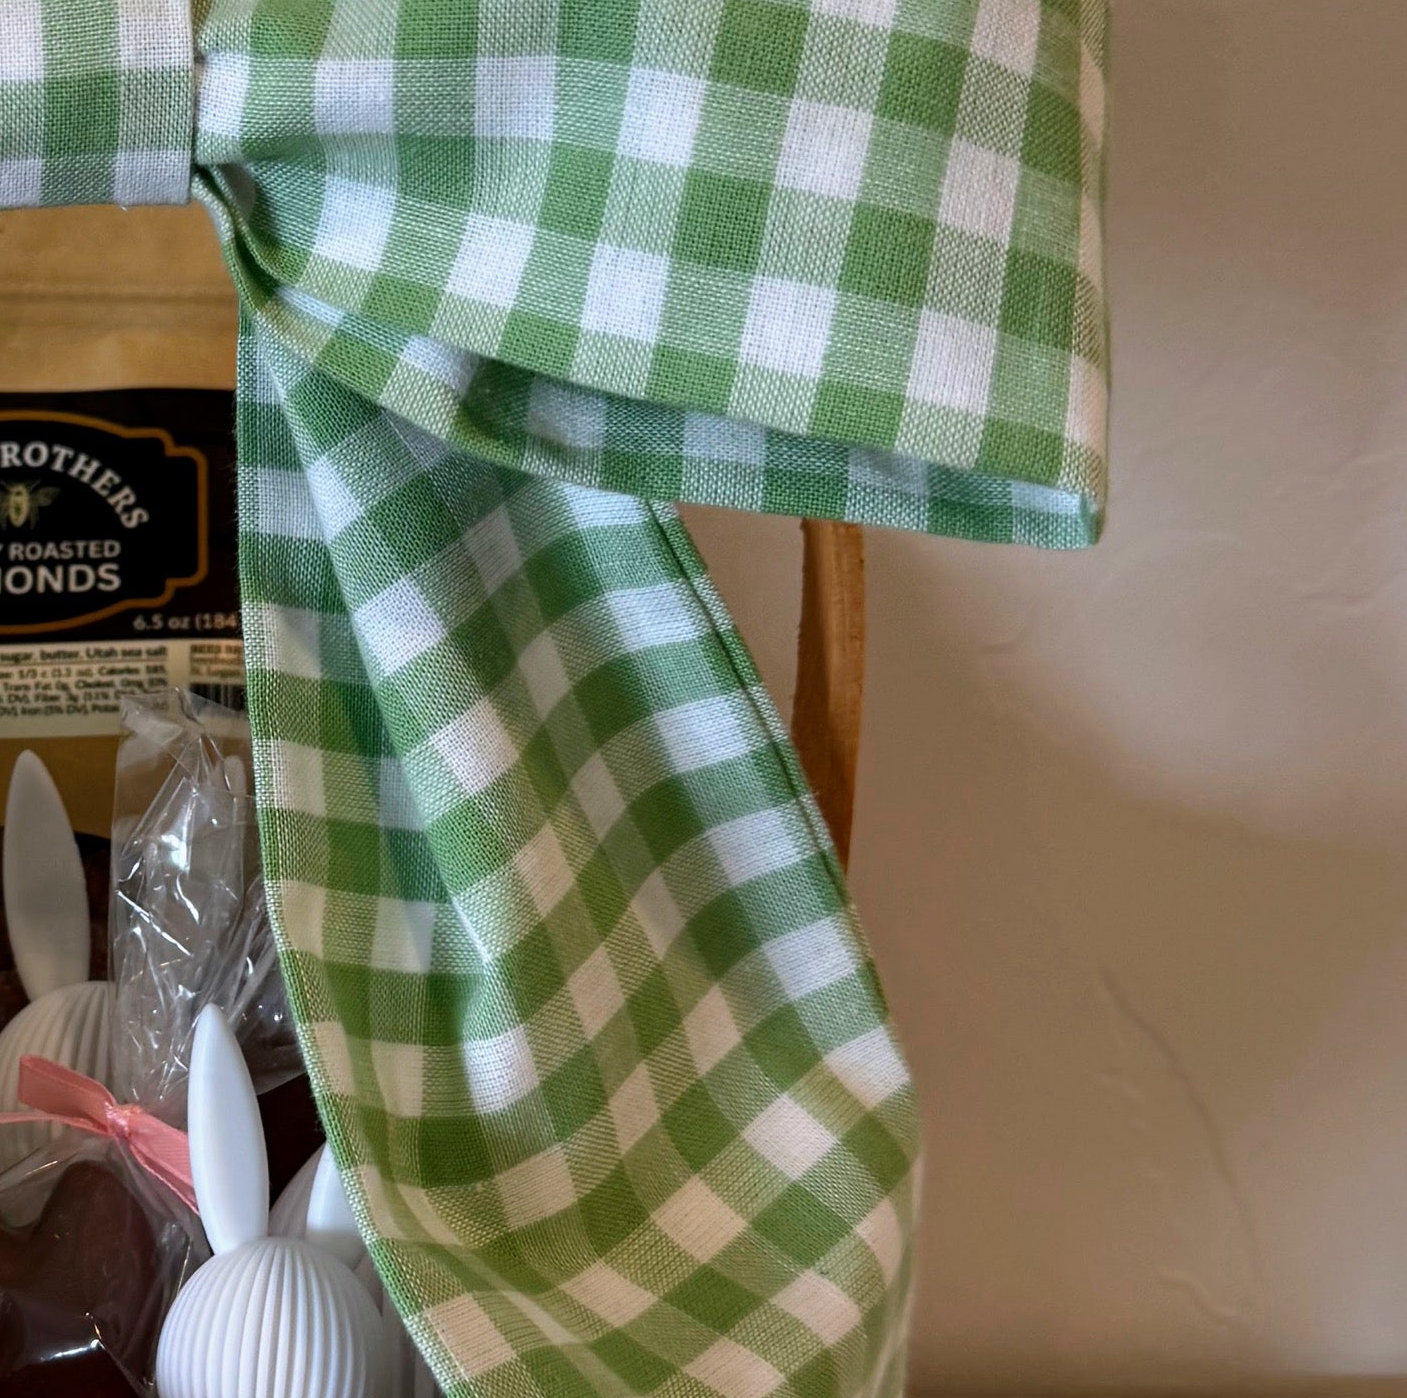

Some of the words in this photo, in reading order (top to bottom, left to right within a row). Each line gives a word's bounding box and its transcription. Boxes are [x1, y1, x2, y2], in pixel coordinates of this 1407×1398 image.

[8, 539, 122, 561] ROASTED
[133, 613, 164, 631] 6.5
[167, 616, 191, 629] oz
[86, 647, 118, 659] Utah
